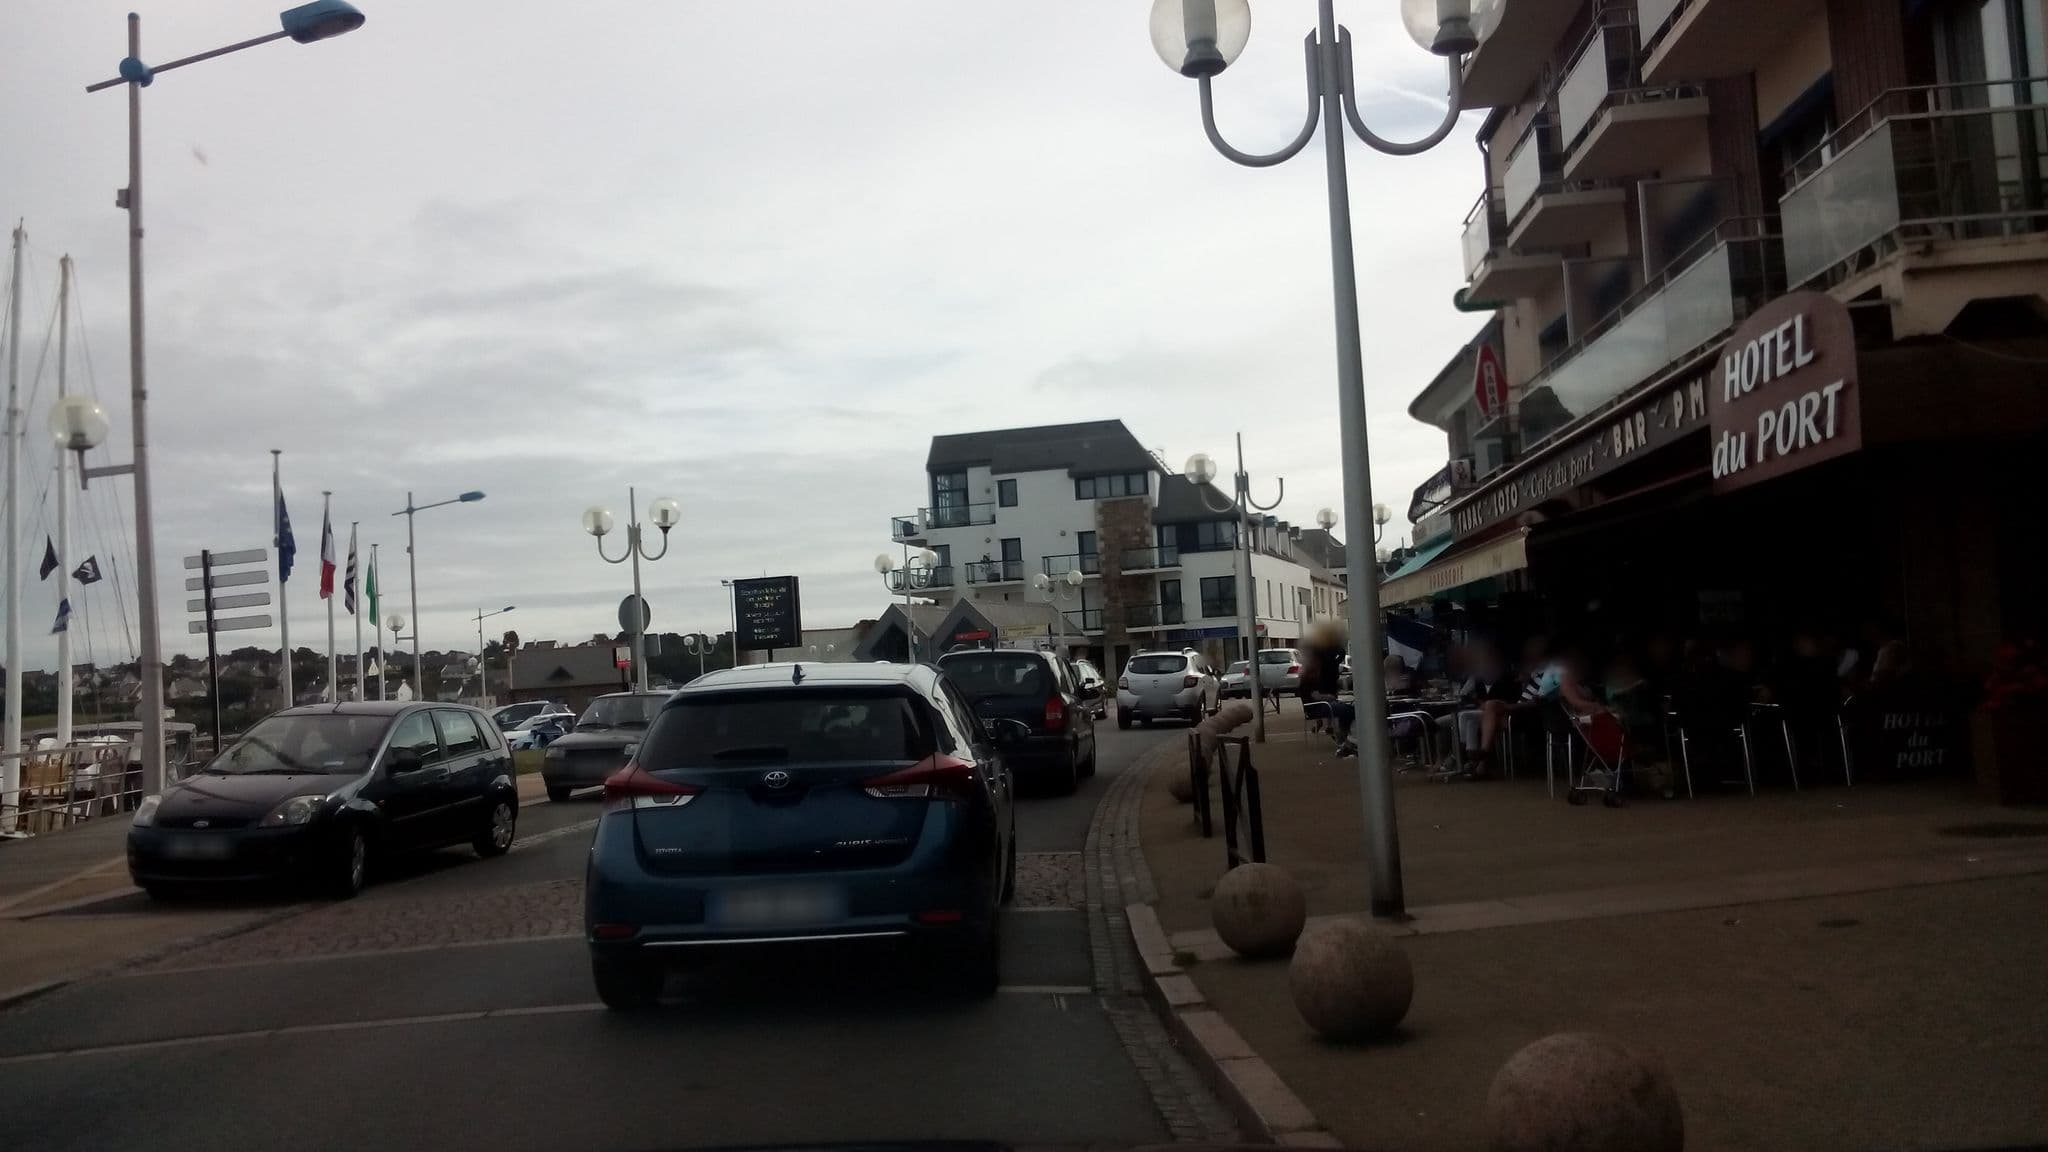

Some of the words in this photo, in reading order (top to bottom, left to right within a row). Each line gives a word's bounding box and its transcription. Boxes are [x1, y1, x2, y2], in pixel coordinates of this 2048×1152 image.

[1724, 313, 1814, 403] HOTEL
[1459, 500, 1483, 534] TABAC
[1555, 462, 1567, 487] du
[1570, 445, 1594, 486] port
[1612, 410, 1647, 459] BAR
[1712, 430, 1747, 480] du
[1757, 379, 1844, 464] PORT
